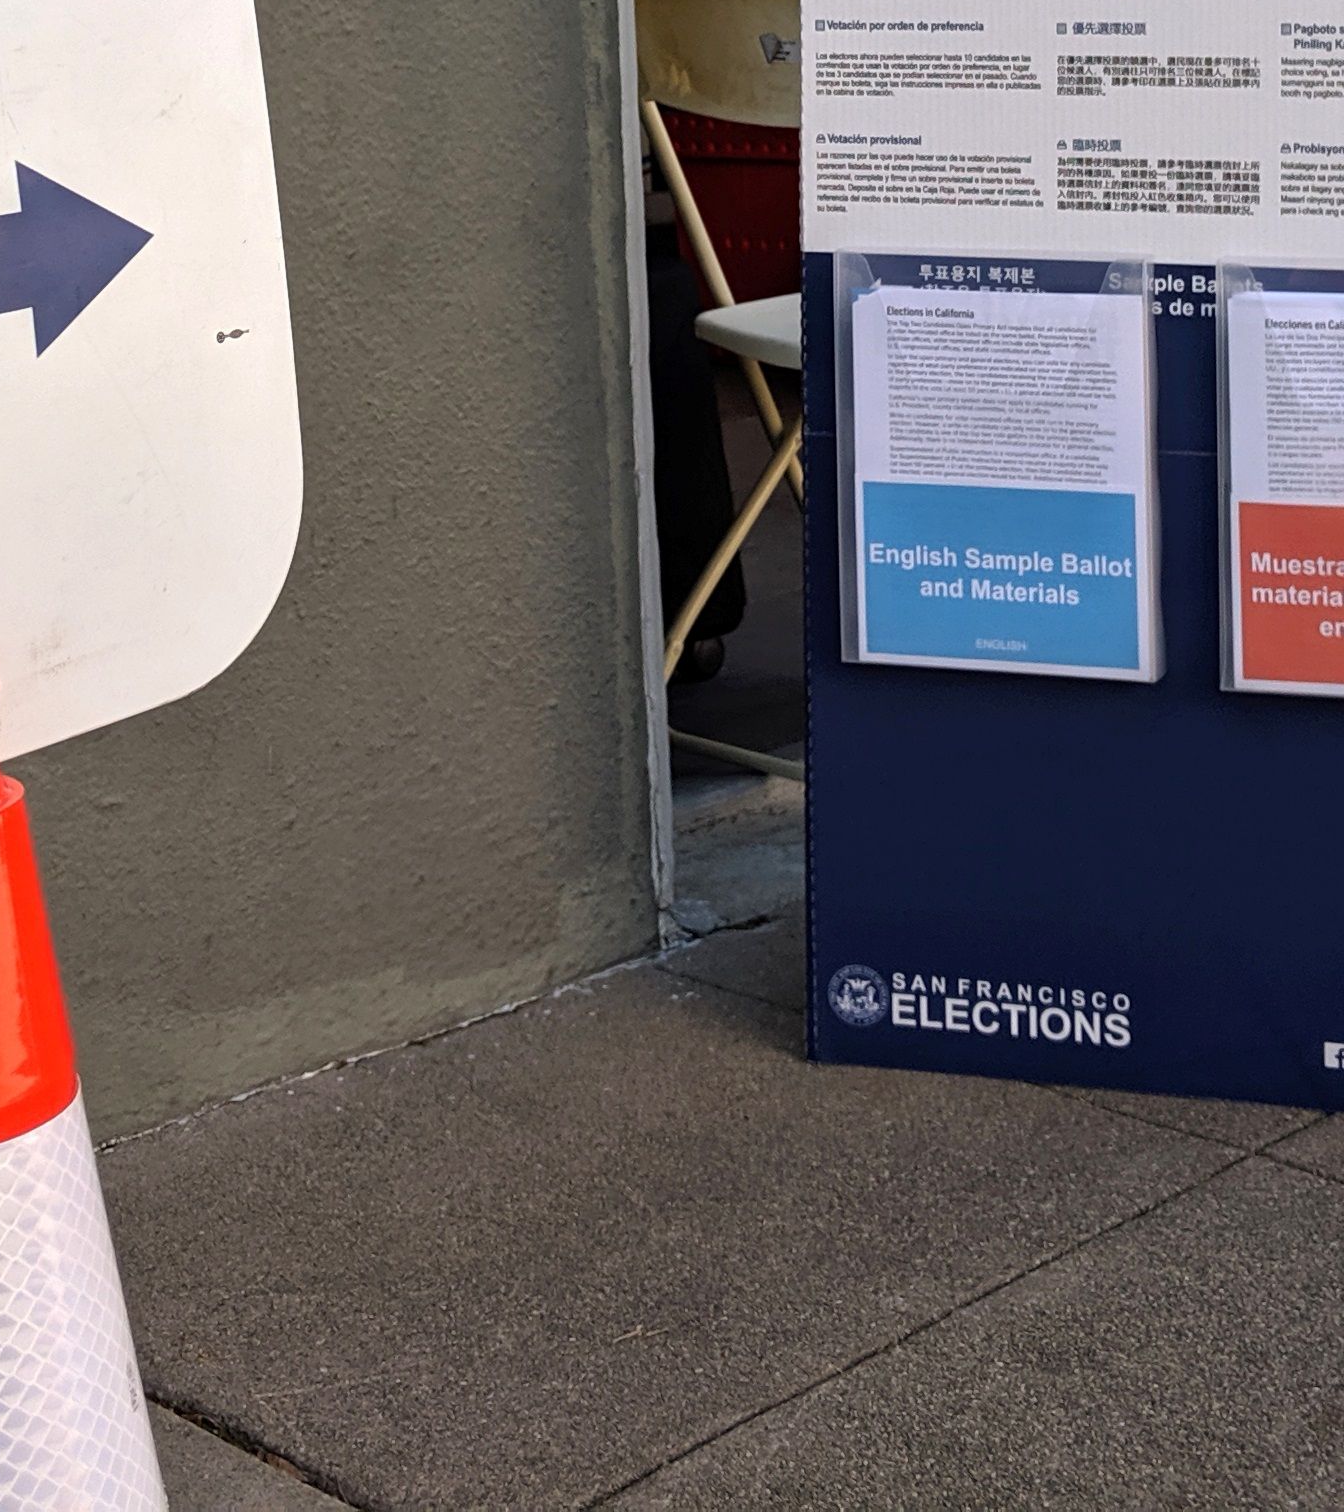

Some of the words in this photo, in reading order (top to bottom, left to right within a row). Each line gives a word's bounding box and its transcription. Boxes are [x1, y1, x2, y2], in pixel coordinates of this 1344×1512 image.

[827, 19, 867, 31] Votación
[869, 22, 885, 32] por
[887, 21, 914, 31] orden
[917, 21, 928, 31] de
[931, 21, 984, 33] preferencia
[1293, 23, 1336, 36] Pagboto
[1294, 38, 1332, 52] Piniling
[827, 133, 867, 144] Votación
[870, 134, 922, 147] provisional
[919, 265, 980, 283] 투표용지
[988, 266, 1035, 285] 복제본
[886, 305, 923, 317] Elections
[925, 307, 933, 317] in
[935, 308, 974, 320] California
[1168, 298, 1195, 317] de
[1265, 319, 1313, 330] Elecciones
[1315, 321, 1326, 330] en
[869, 542, 957, 570] English
[965, 547, 1053, 577] Sample
[1062, 552, 1132, 577] Ballot
[920, 578, 963, 599] and
[971, 578, 1079, 605] Materials
[975, 638, 1029, 652] ENGLISH
[893, 973, 946, 994] SAN
[958, 978, 1130, 1011] FRANCISCO
[892, 993, 1130, 1047] ELECTIONS
